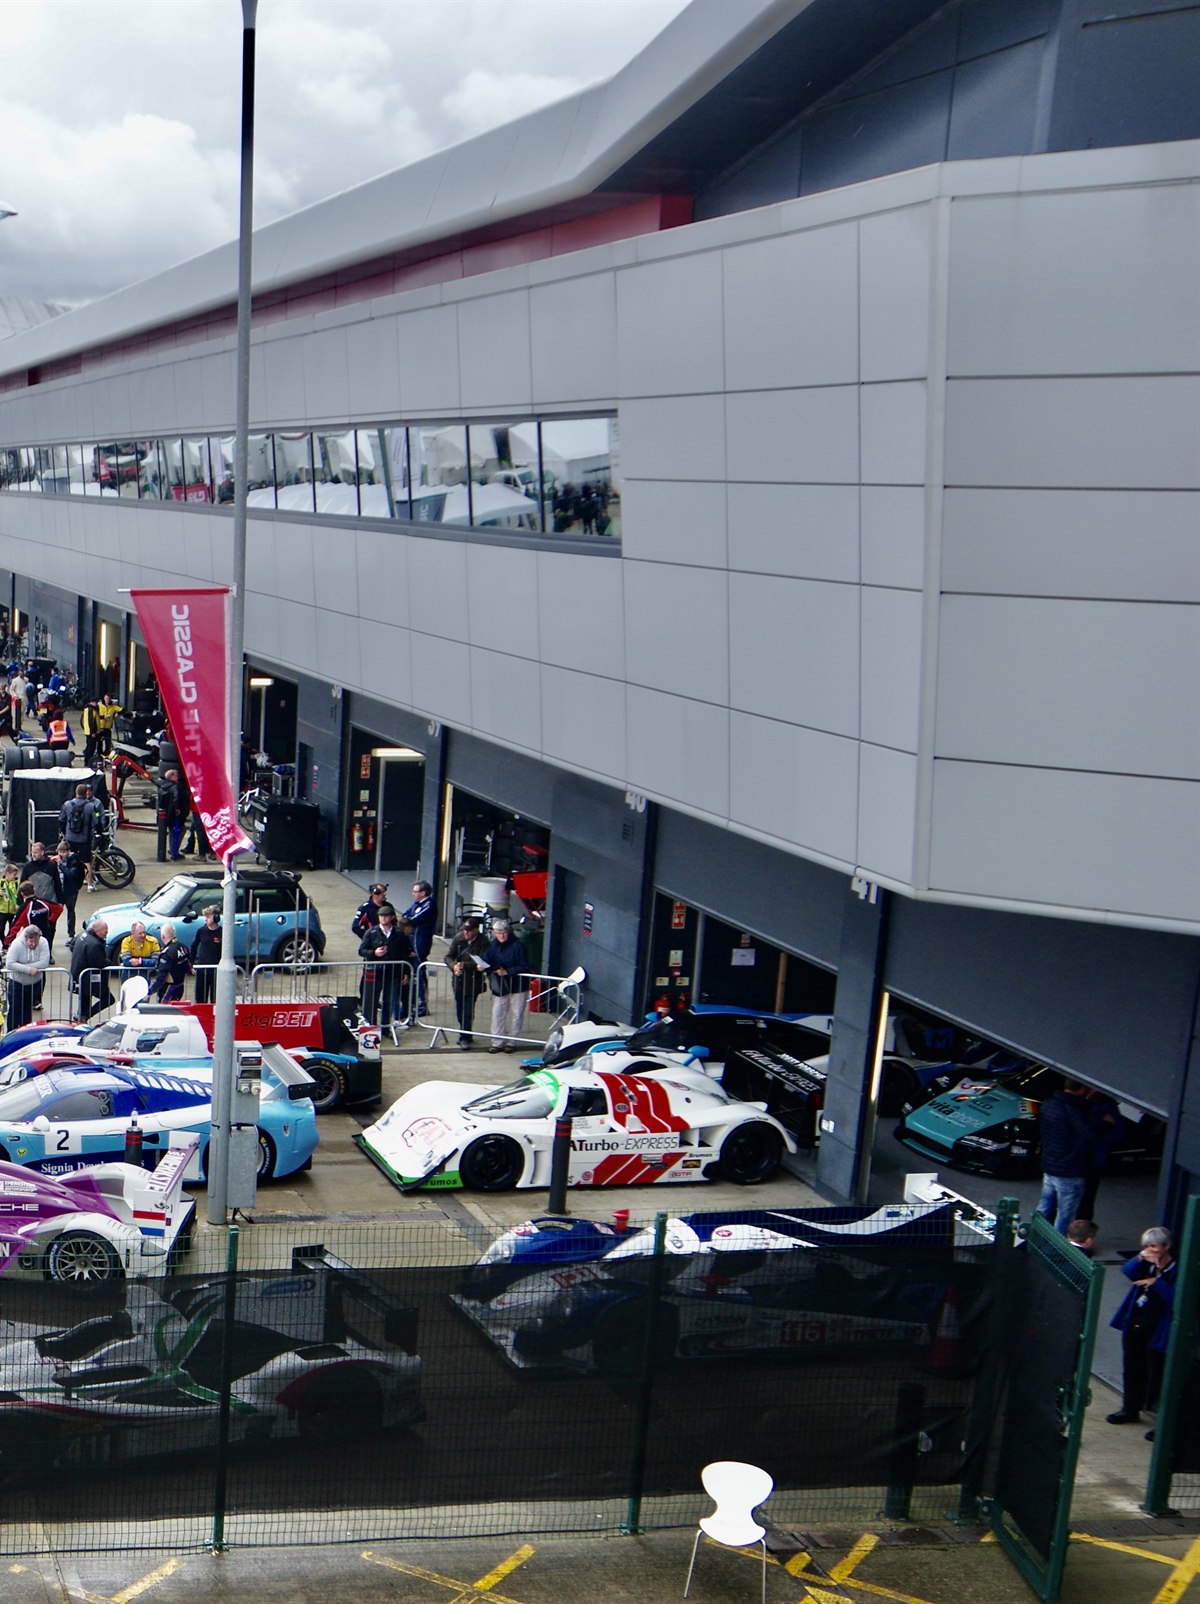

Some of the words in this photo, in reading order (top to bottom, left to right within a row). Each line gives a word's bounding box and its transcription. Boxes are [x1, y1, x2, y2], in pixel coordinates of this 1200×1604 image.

[851, 876, 878, 905] 41
[928, 1100, 987, 1128] vitaphone
[56, 1129, 70, 1151] 2
[41, 1162, 74, 1176] Signia
[422, 1178, 458, 1188] rumos
